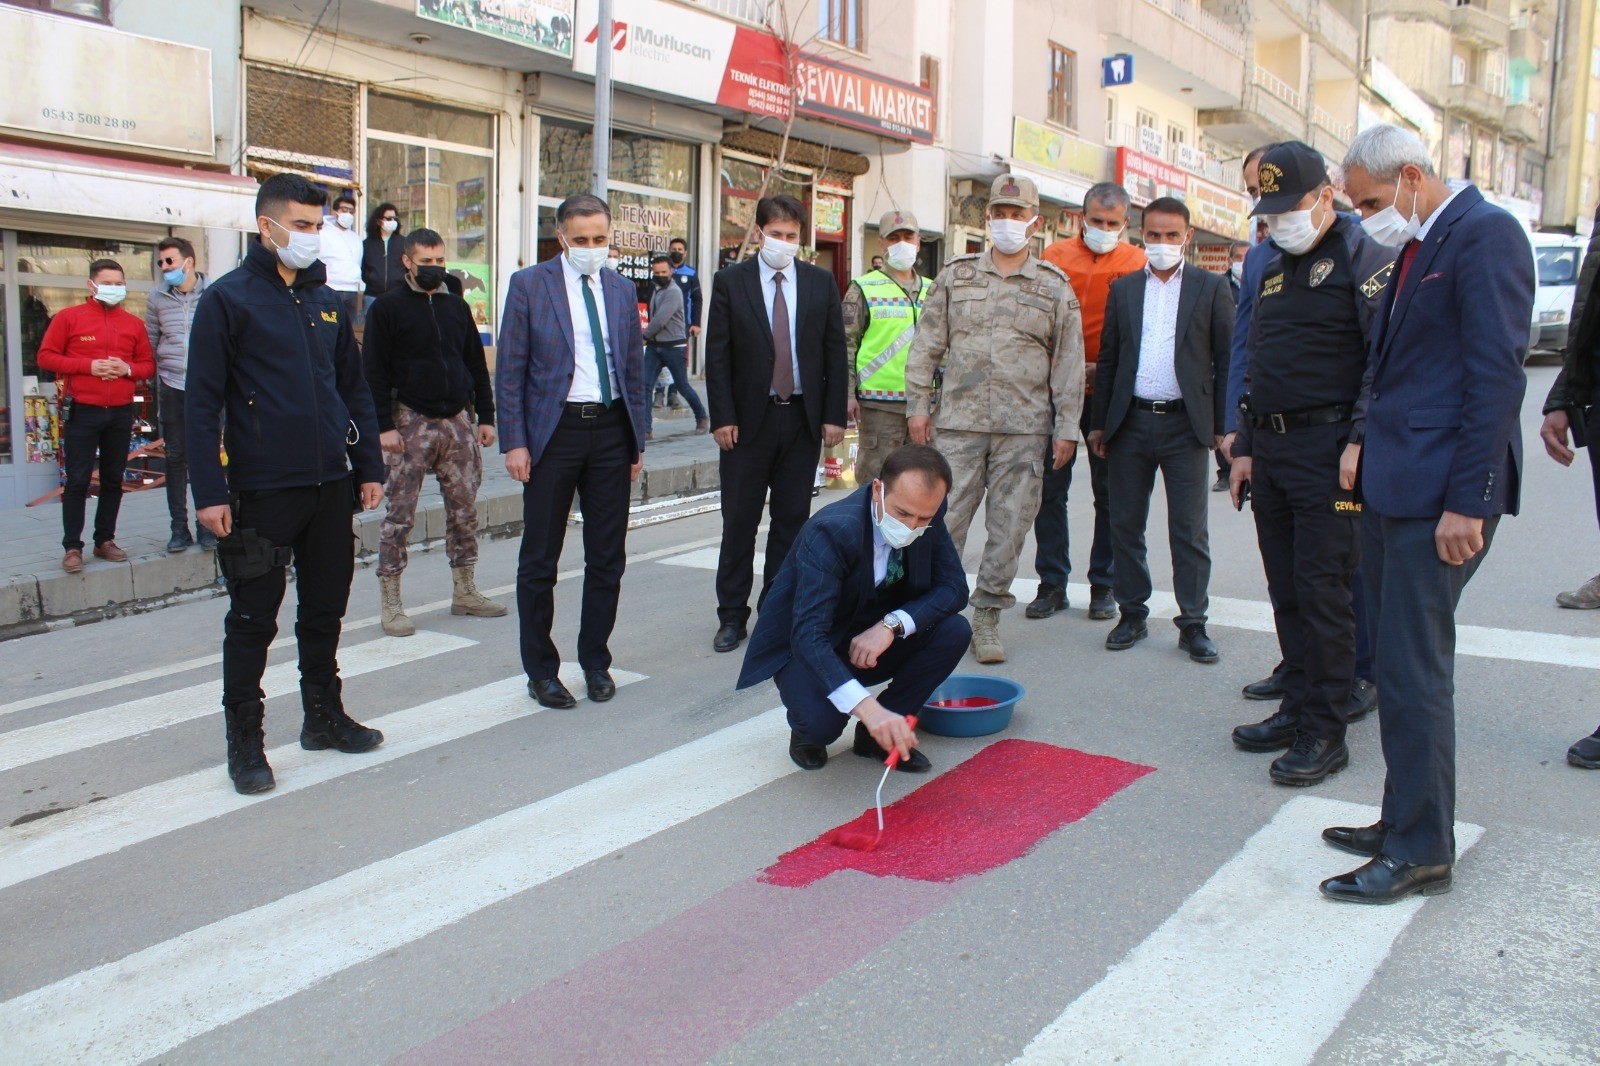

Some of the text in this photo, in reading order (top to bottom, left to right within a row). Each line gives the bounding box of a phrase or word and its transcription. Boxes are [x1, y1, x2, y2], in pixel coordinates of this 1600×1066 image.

[632, 45, 671, 64] electric
[634, 25, 711, 61] Mutlusan
[730, 68, 758, 87] TEKNİK
[797, 62, 931, 131] ŞEVVAL MARKET
[42, 107, 137, 131] 0543 508 28 89
[621, 205, 671, 228] TEKNİK
[613, 229, 673, 252] ELEKTRİ
[634, 256, 649, 267] 443
[634, 268, 649, 279] 589
